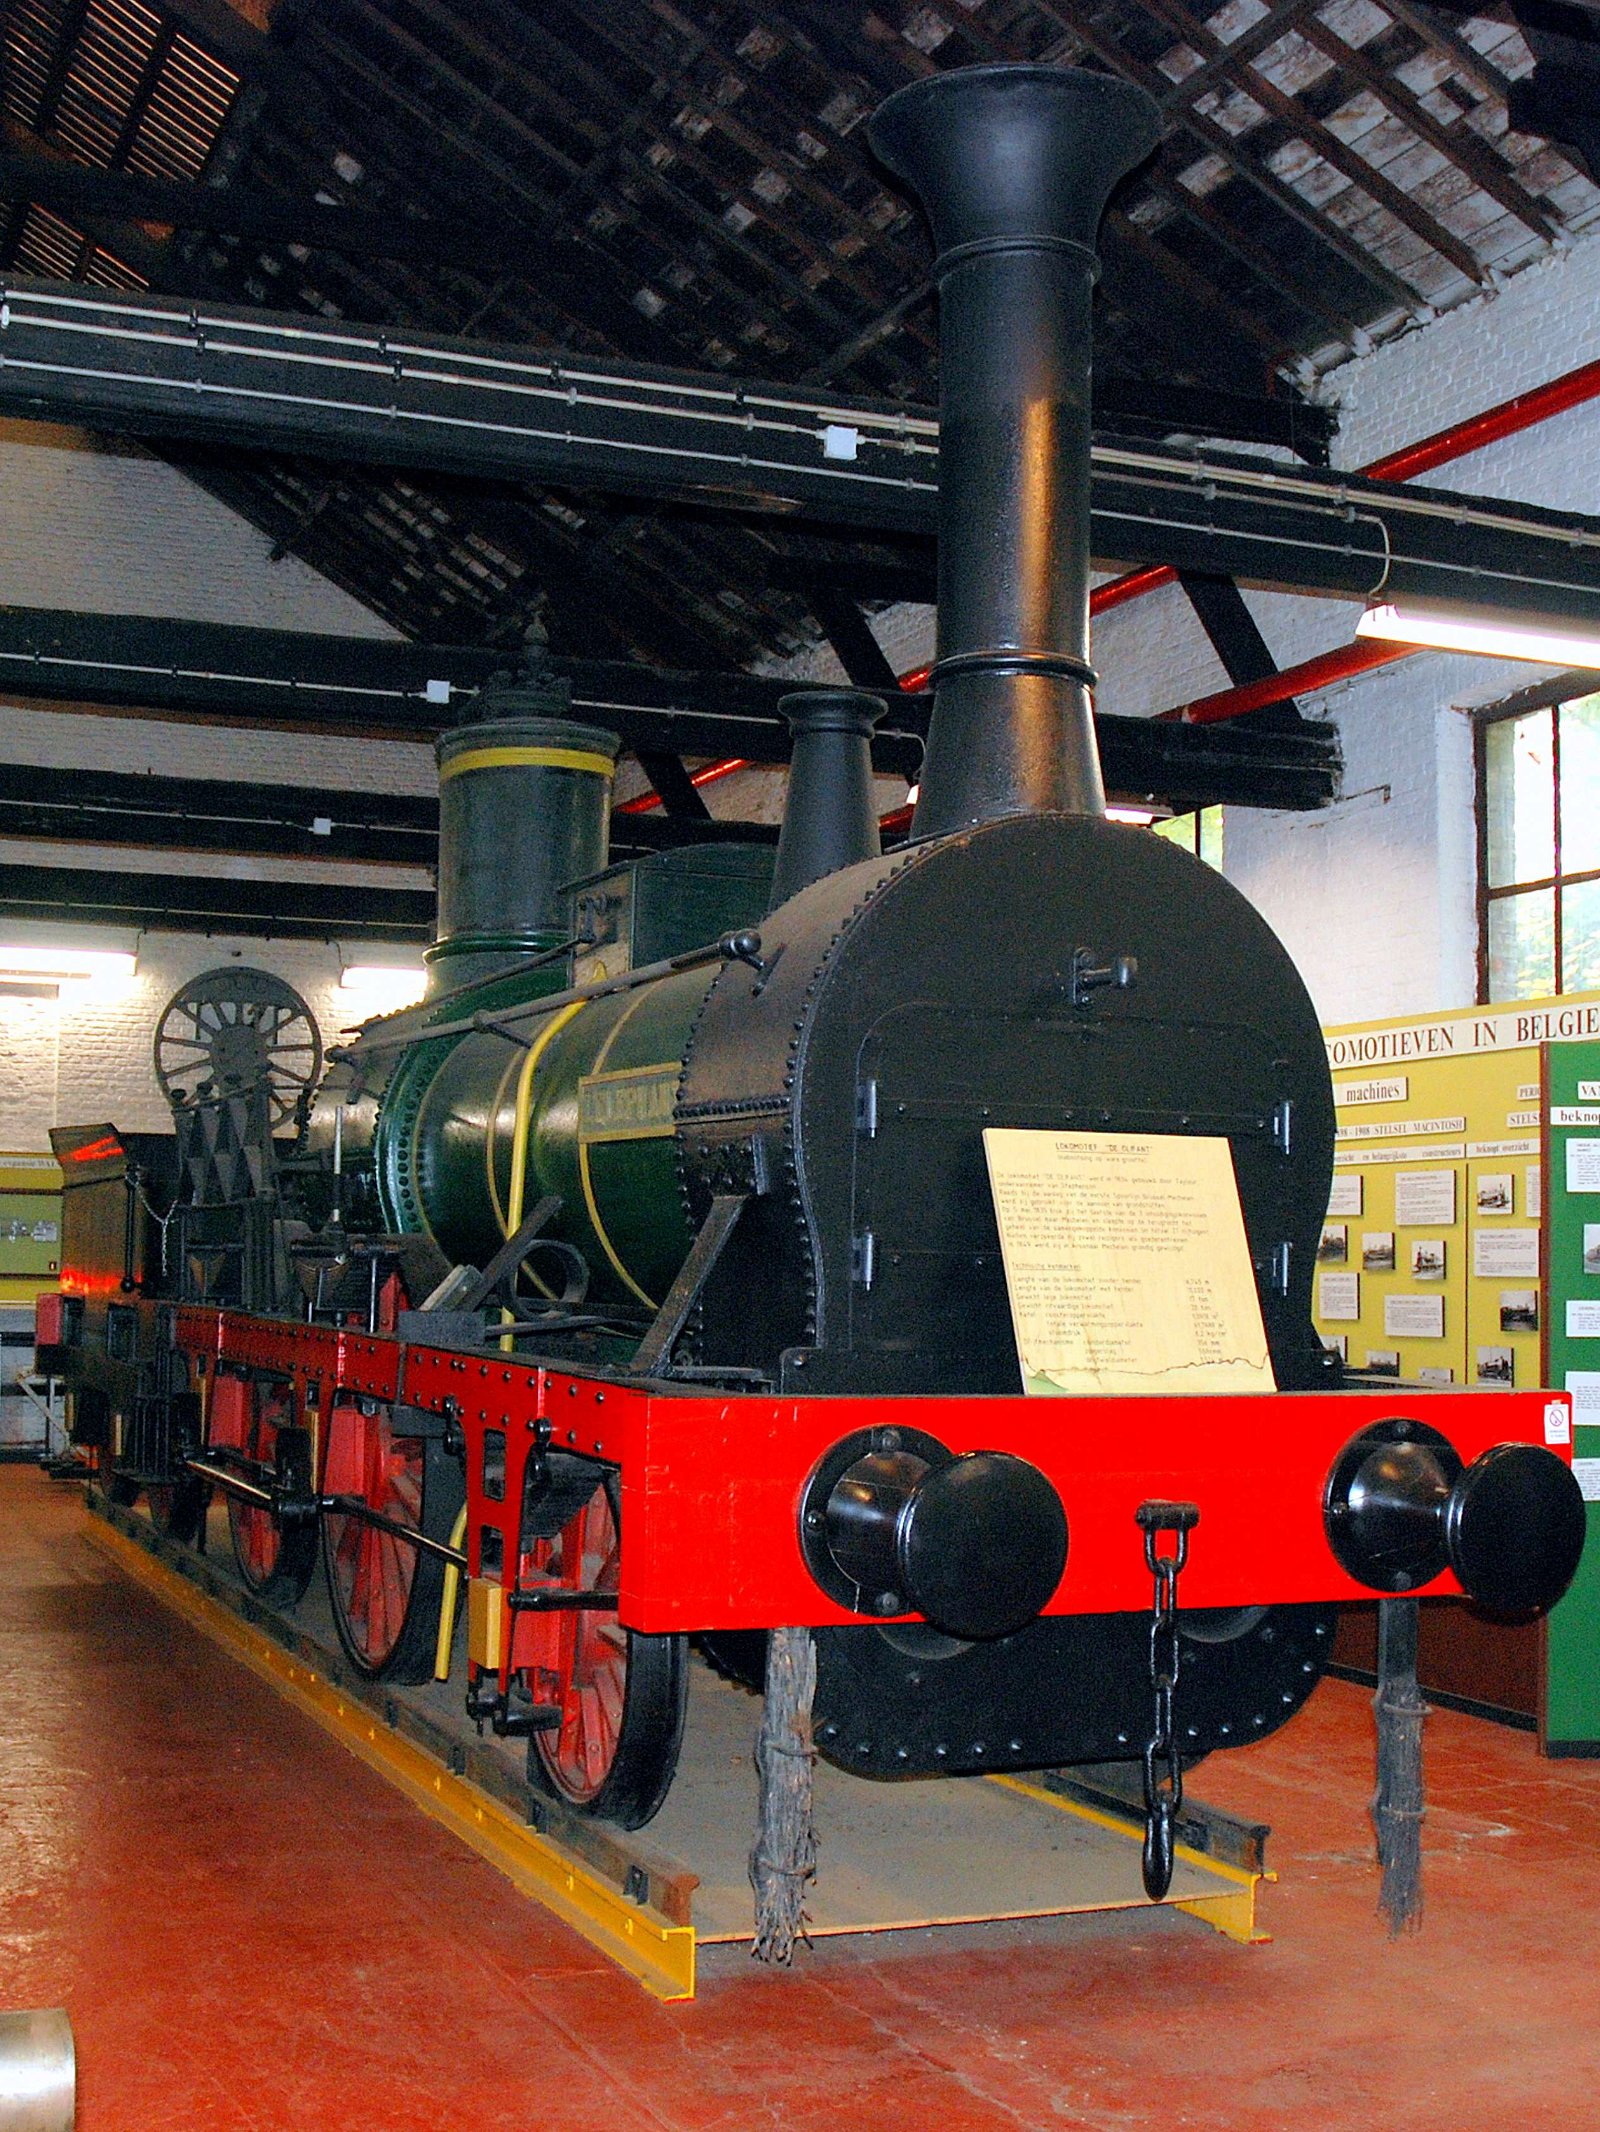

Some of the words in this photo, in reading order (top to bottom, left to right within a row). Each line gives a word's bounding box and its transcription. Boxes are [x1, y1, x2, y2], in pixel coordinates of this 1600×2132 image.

[1325, 1026, 1454, 1064] OMOTIEVEN
[1473, 1020, 1498, 1047] IN
[1517, 1007, 1599, 1042] BELGIE
[1346, 1082, 1400, 1102] machines
[1519, 1087, 1539, 1098] PERI
[1375, 1123, 1407, 1135] STELSEL
[1413, 1119, 1462, 1132] MACINTOSH
[1510, 1113, 1538, 1125] STELS
